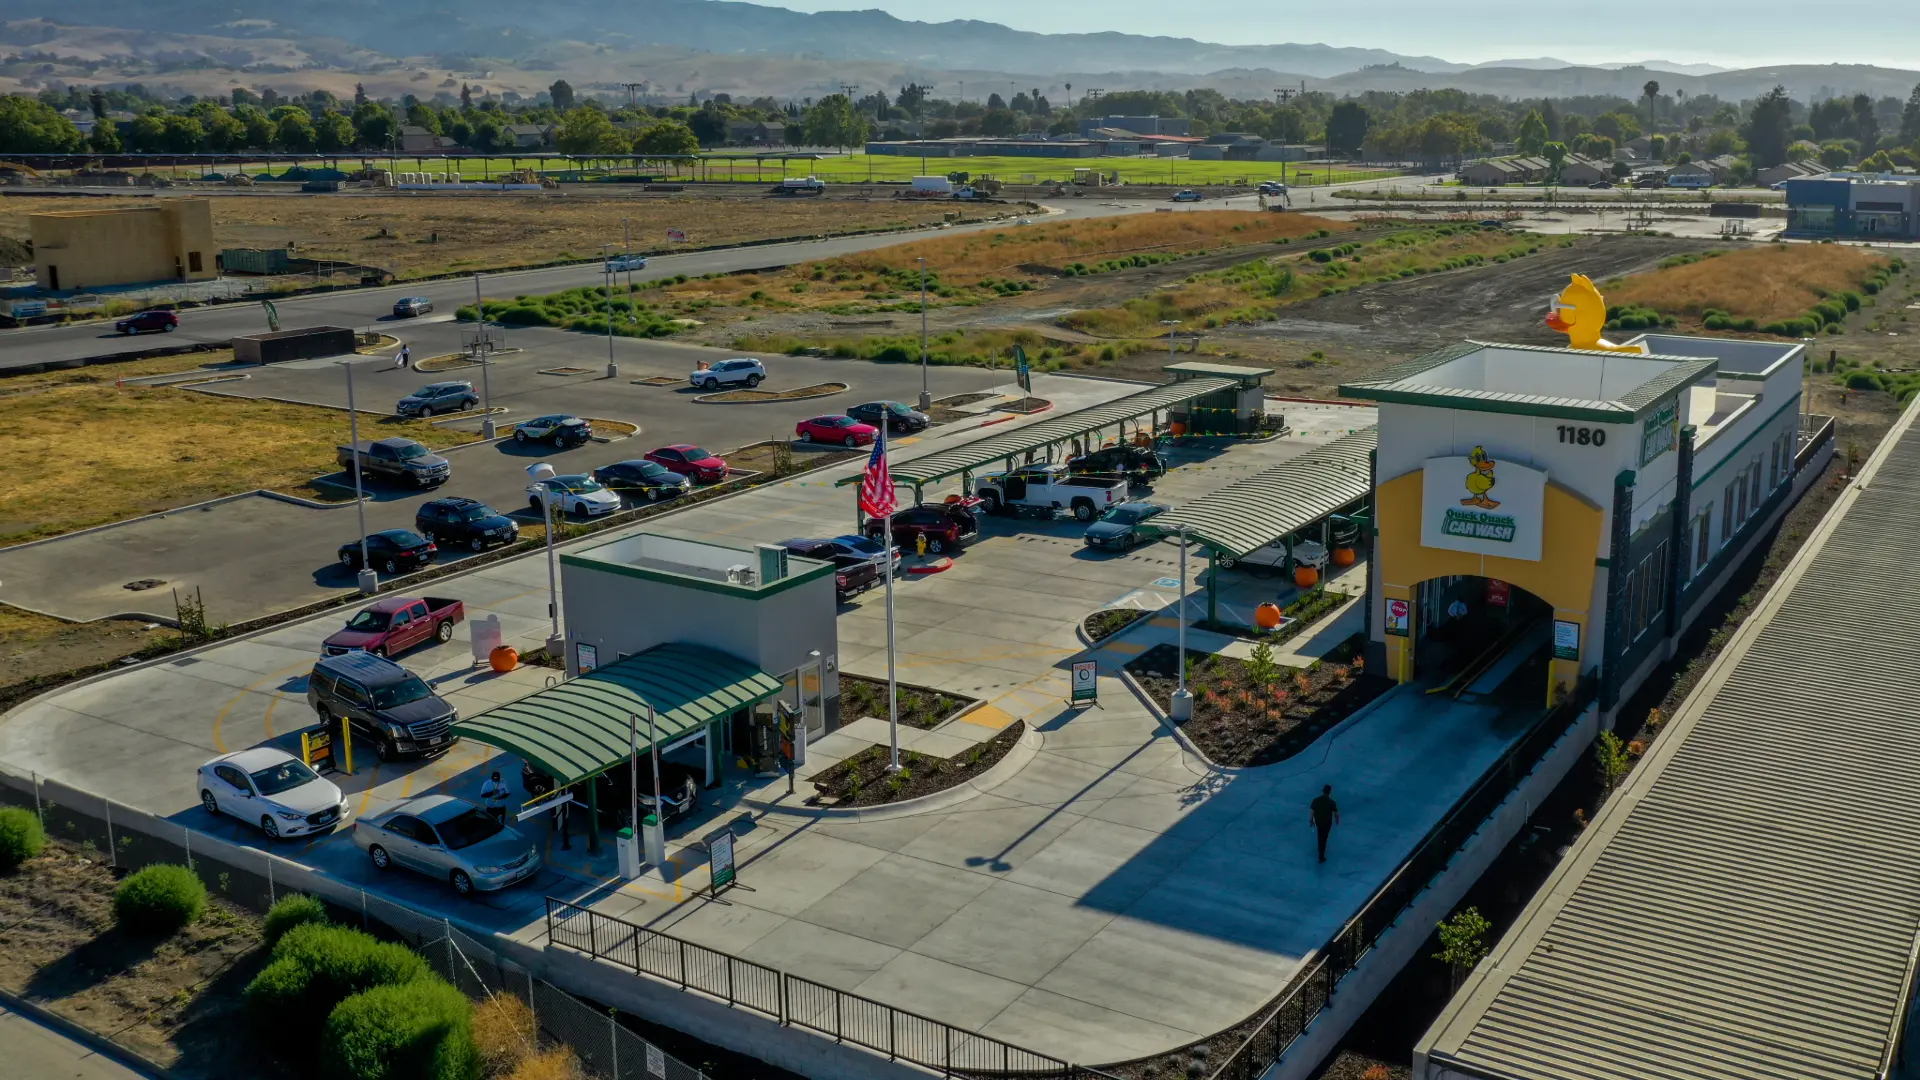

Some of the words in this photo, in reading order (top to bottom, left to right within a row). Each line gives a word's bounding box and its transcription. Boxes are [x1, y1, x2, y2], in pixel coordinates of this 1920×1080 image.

[1557, 425, 1606, 447] 1180
[1446, 509, 1477, 521] Quick
[1480, 513, 1514, 525] Quack
[1449, 521, 1474, 535] CAR
[1476, 524, 1512, 540] WASH
[1392, 605, 1407, 613] STOP
[1075, 663, 1095, 671] HOURS
